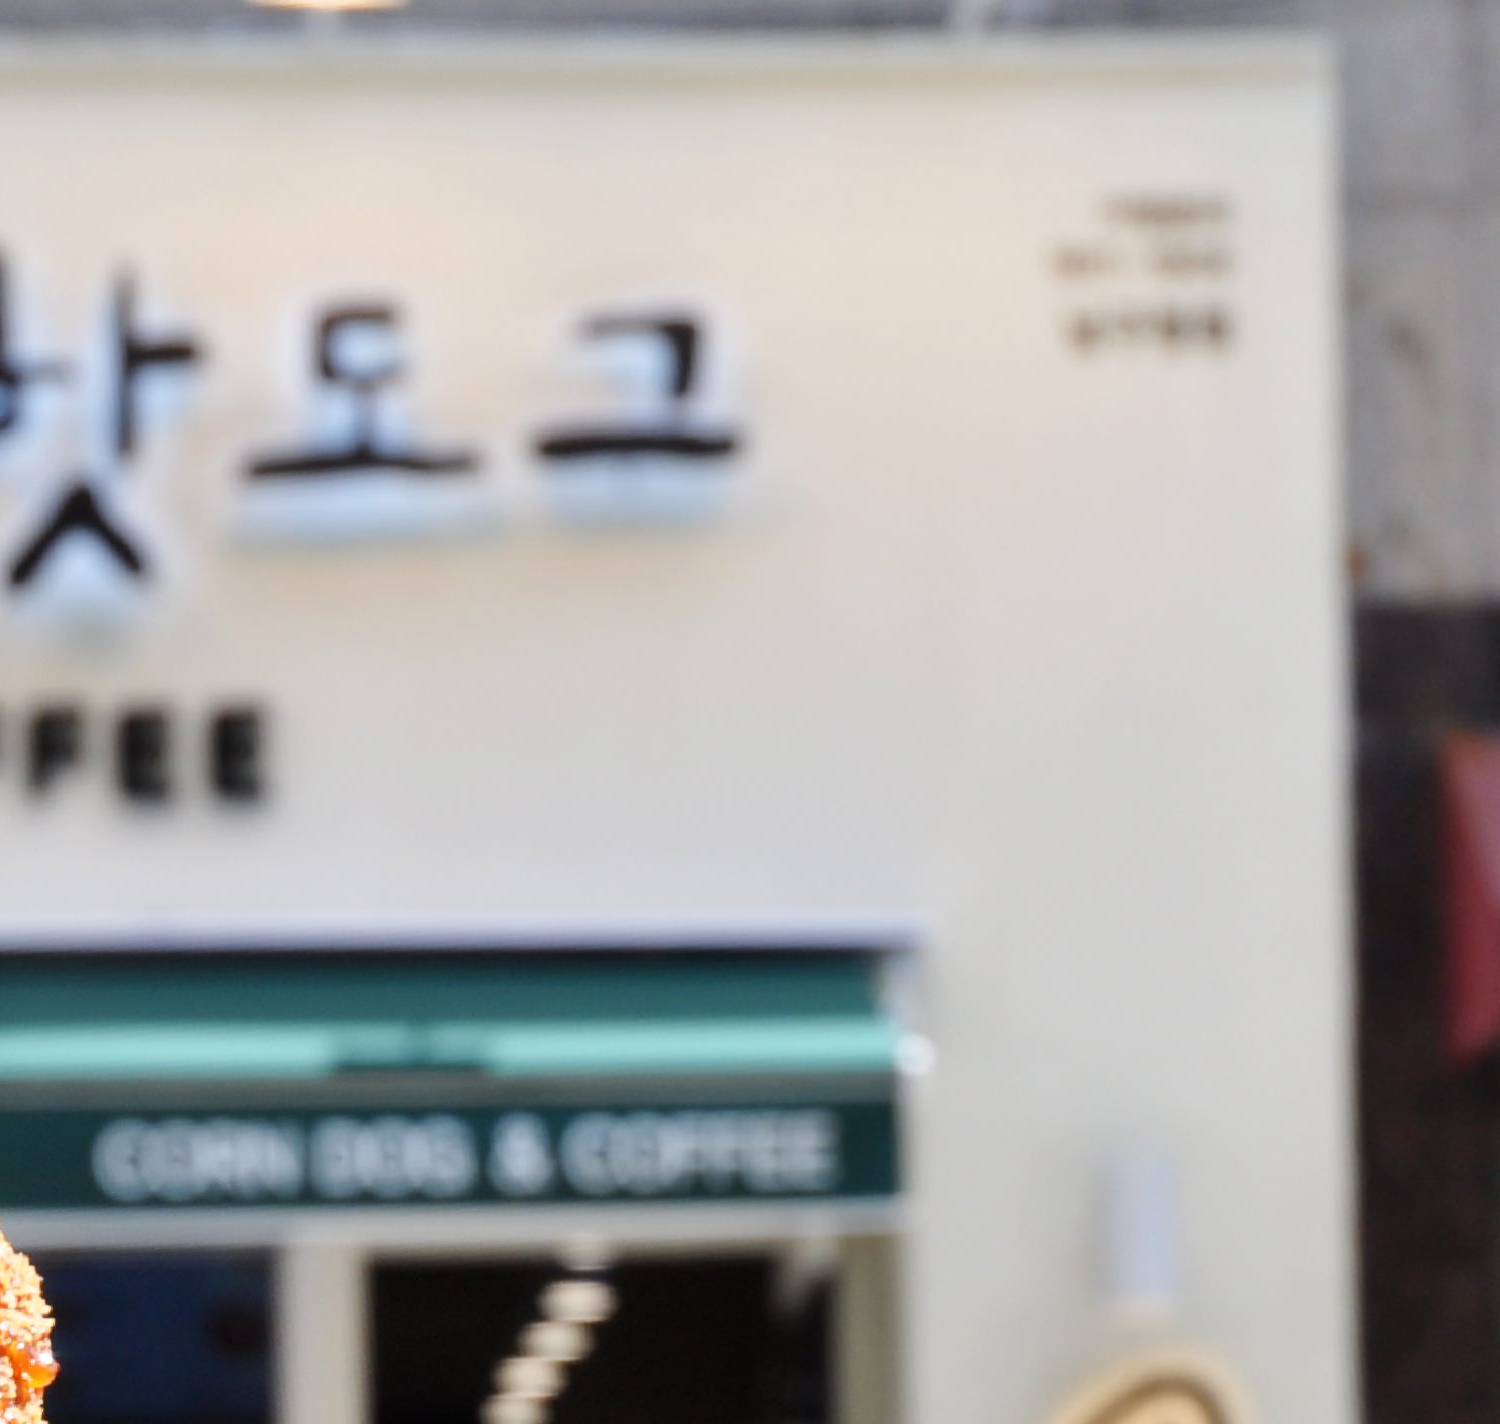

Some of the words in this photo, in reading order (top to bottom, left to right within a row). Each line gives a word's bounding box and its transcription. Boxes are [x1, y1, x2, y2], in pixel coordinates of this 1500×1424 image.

[94, 1119, 299, 1198] CORN
[311, 1116, 474, 1197] DOG
[490, 1114, 550, 1195] &
[563, 1111, 837, 1194] COFFEE
